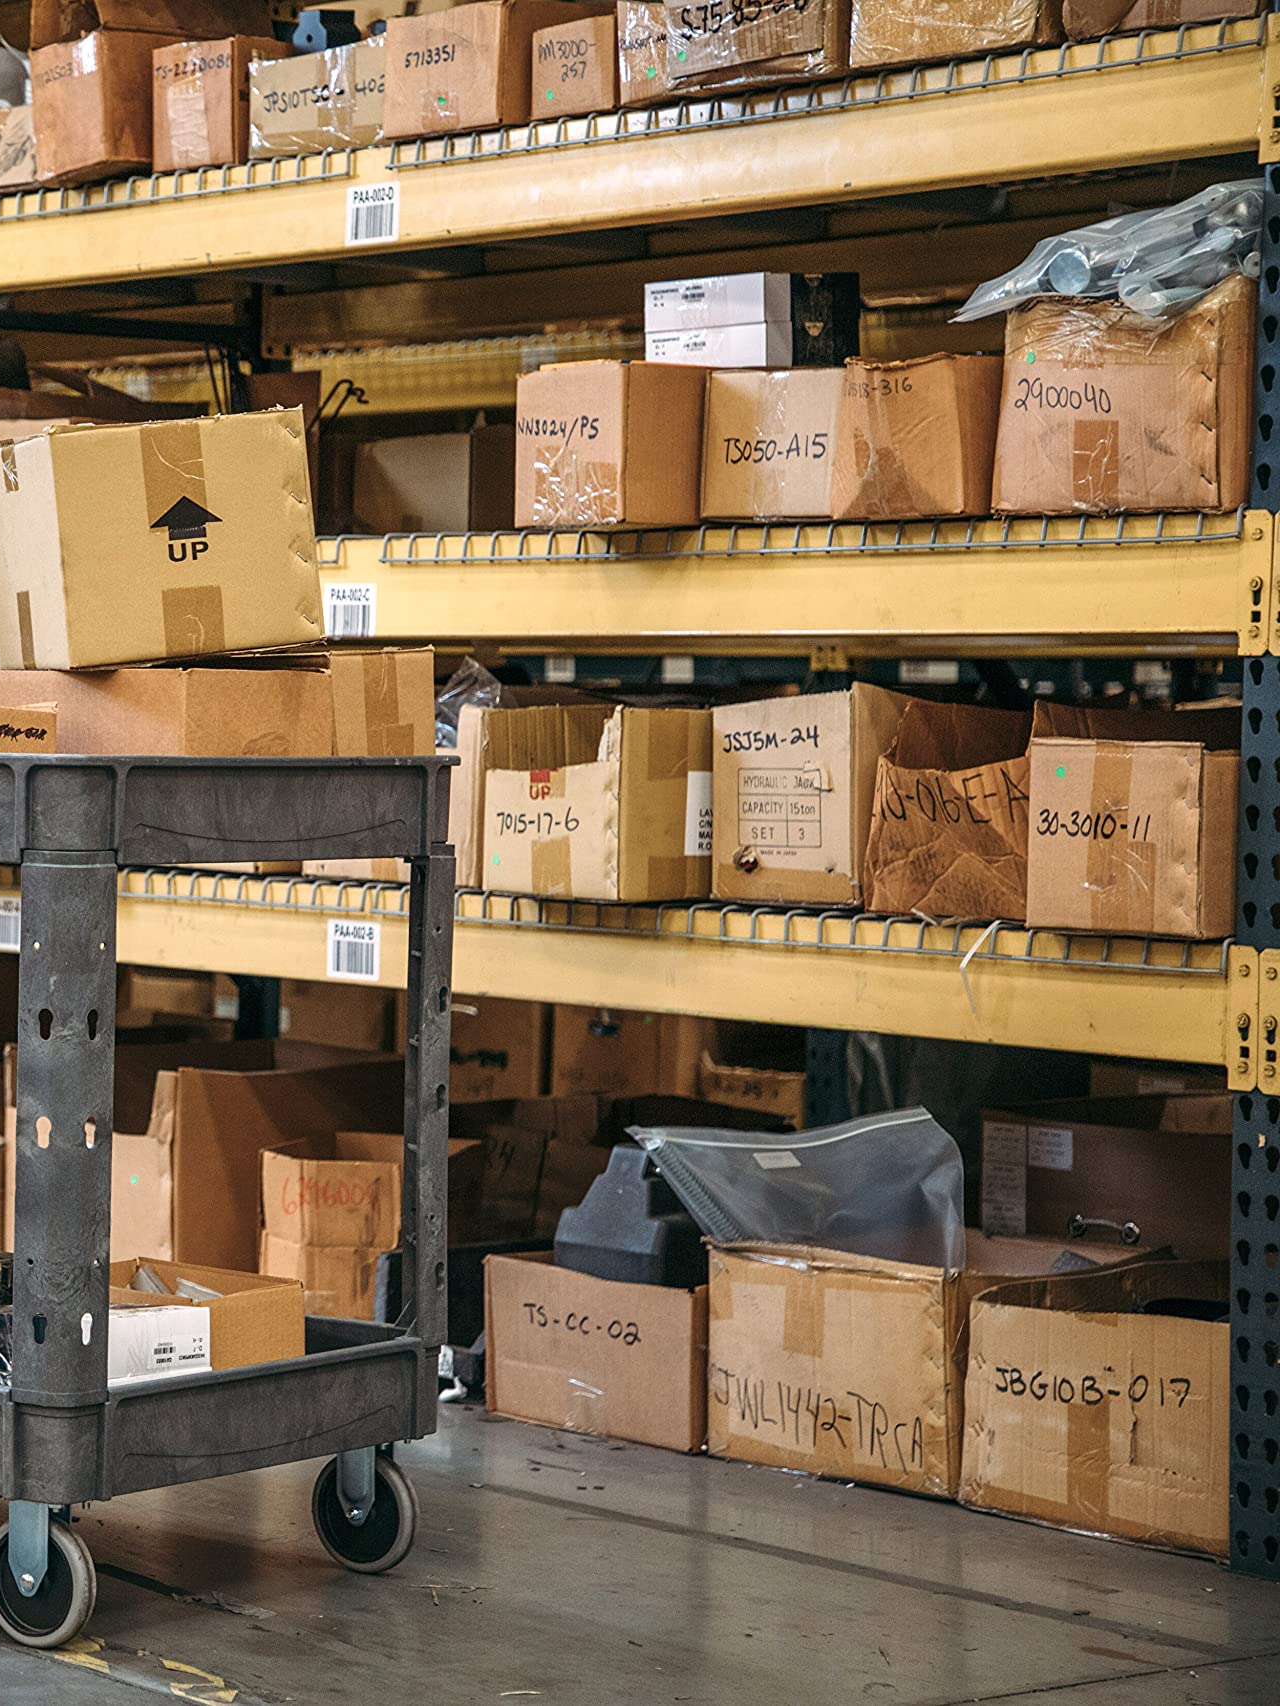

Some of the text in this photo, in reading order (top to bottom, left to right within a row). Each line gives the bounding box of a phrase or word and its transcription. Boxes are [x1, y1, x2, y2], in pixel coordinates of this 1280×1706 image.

[404, 44, 456, 68] 5713351
[560, 60, 588, 81] 257
[352, 185, 395, 205] PAA-002-D
[1014, 376, 1112, 414] 2900040
[167, 540, 209, 562] UP
[330, 588, 372, 603] PAA-002-C
[723, 725, 820, 753] JSJ5M-24
[529, 785, 551, 800] UP
[742, 800, 815, 816] CAPACITY 15ton
[497, 807, 581, 836] 7015-17-6
[1037, 809, 1153, 842] 30-3010-11
[751, 826, 805, 841] SET 3
[334, 925, 374, 940] PAA-002-B
[523, 1303, 641, 1346] TS-CC-02
[995, 1366, 1191, 1406] JBG10B-017
